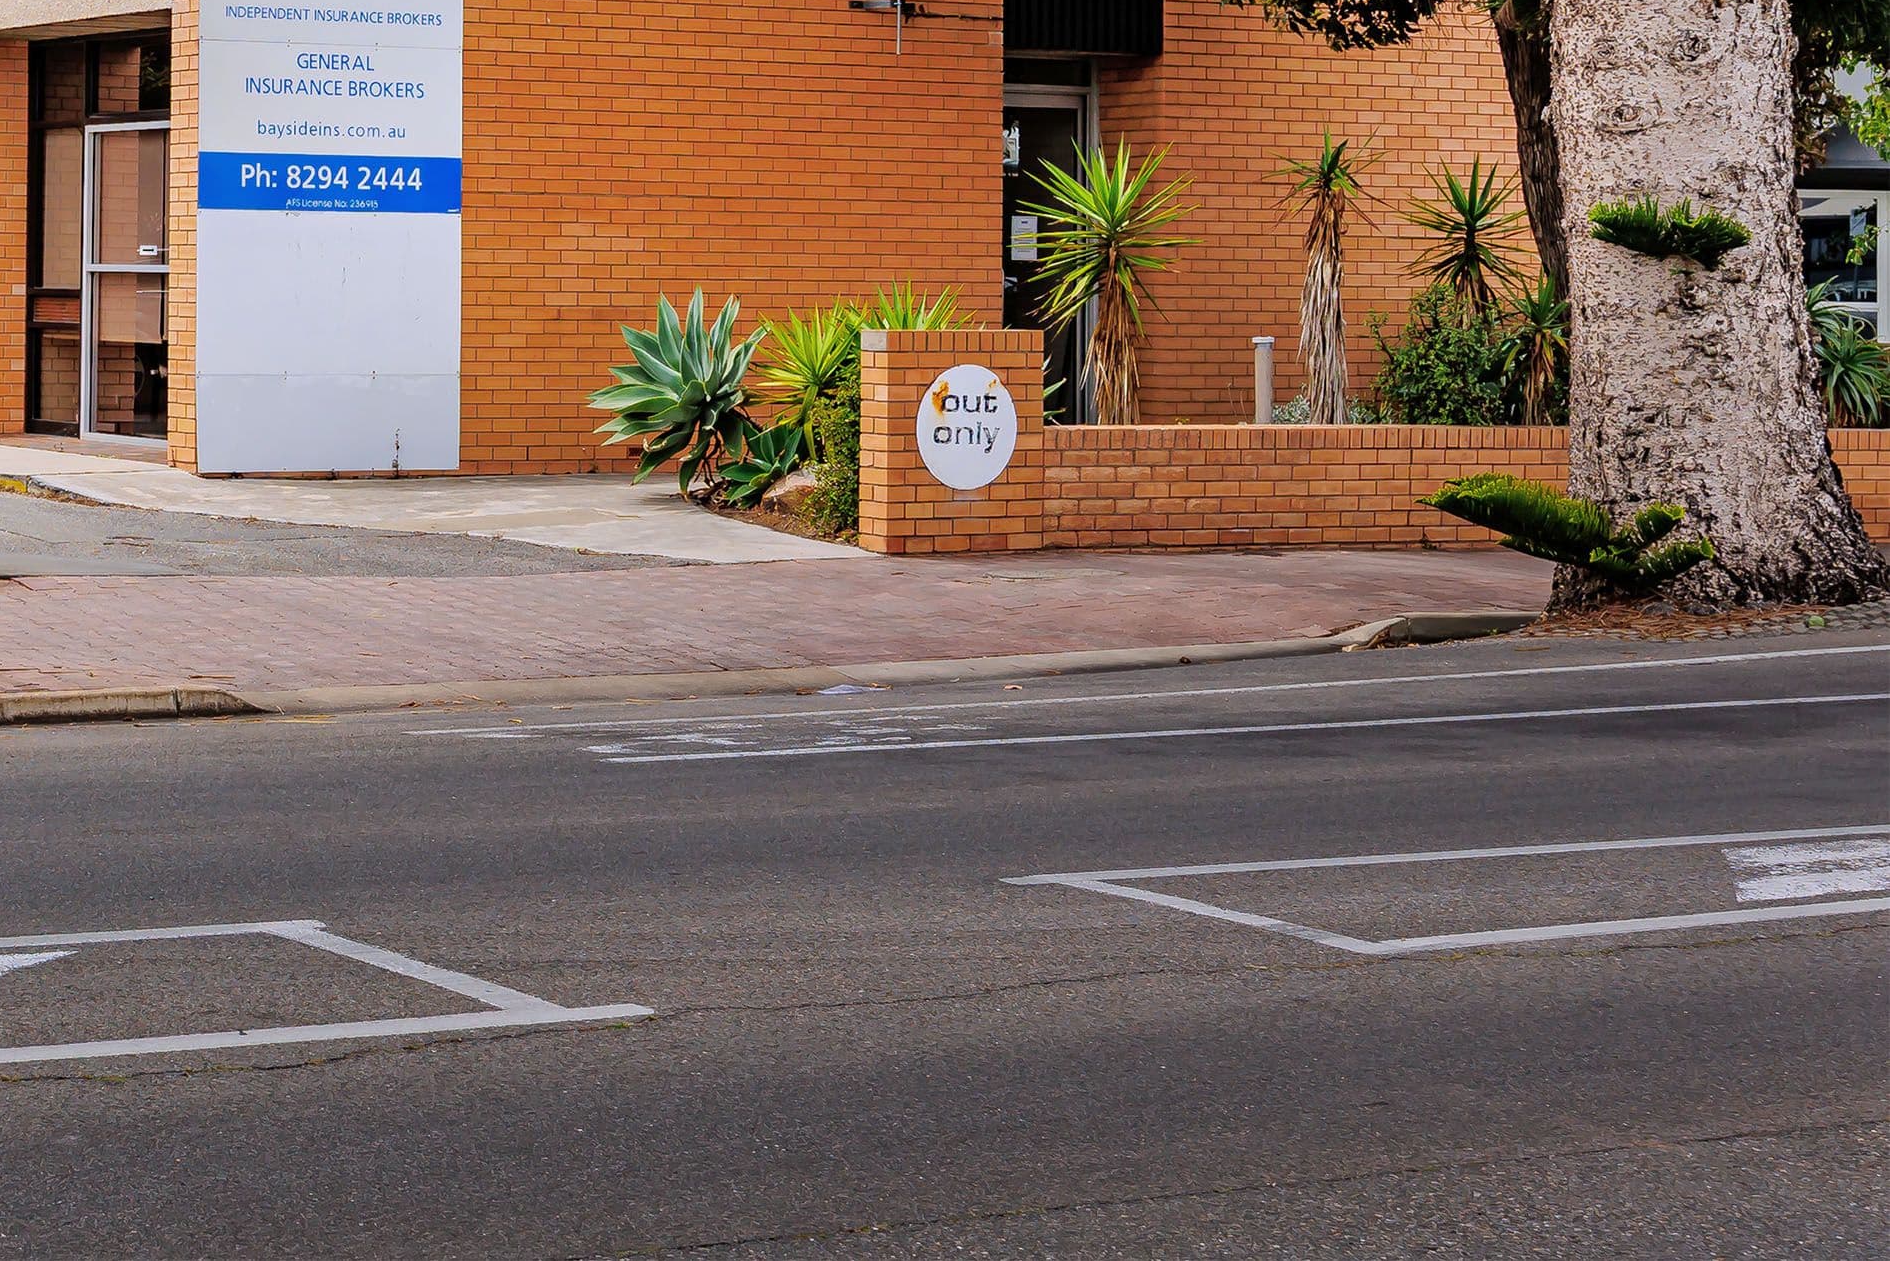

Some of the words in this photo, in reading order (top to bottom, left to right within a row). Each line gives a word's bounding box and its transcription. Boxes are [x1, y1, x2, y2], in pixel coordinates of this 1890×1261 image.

[225, 5, 311, 21] INDEPENDENT
[314, 9, 384, 24] INSURANCE
[387, 12, 443, 27] BROKERS
[296, 52, 375, 72] GENERAL
[245, 77, 343, 96] INSURANCE
[348, 80, 425, 99] BROKERS
[257, 119, 406, 139] baysideins.com.au
[241, 162, 278, 189] Ph:
[286, 164, 349, 190] 8294
[357, 166, 423, 191] 2444
[286, 198, 301, 208] AFS
[941, 390, 998, 414] out
[932, 421, 1000, 454] only
